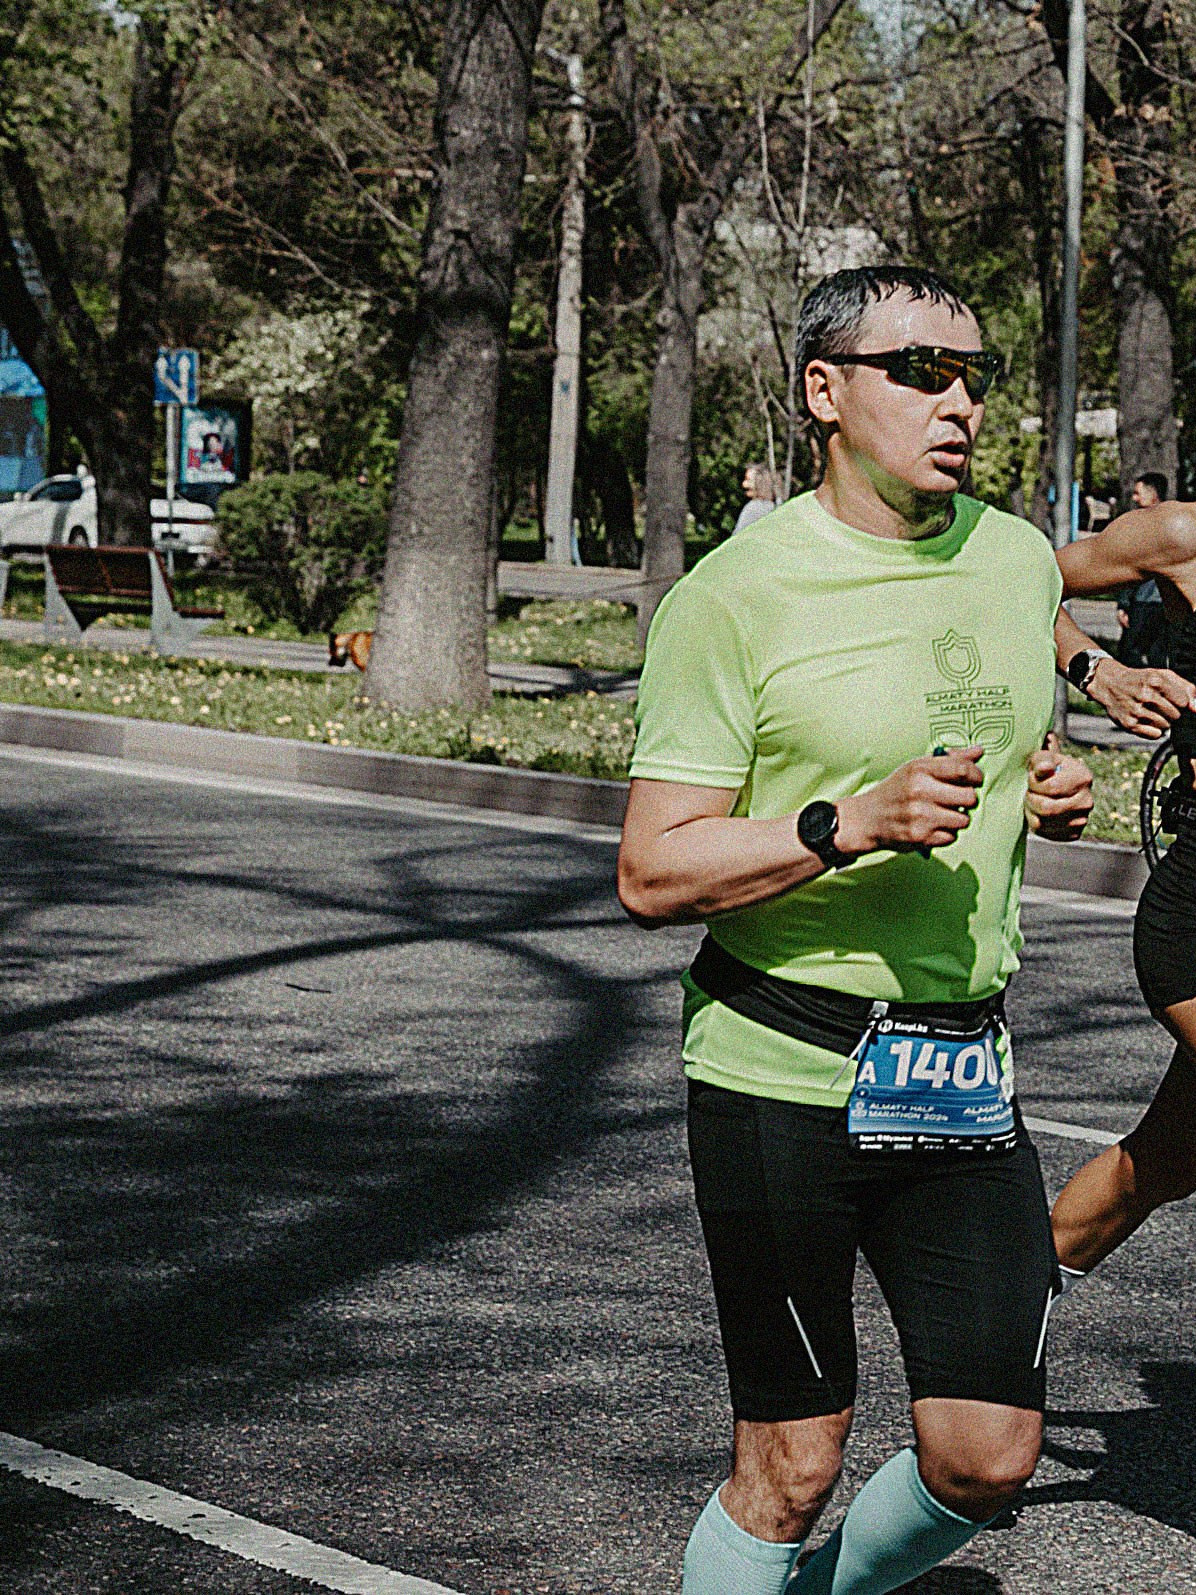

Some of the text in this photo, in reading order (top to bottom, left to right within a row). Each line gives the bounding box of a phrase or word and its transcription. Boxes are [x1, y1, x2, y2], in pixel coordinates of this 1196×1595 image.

[926, 688, 1010, 703] ALMATY HALF
[940, 700, 1012, 712] MARATHON
[857, 1061, 876, 1084] A
[869, 1103, 908, 1111] ALMATY
[868, 1110, 922, 1119] MARATHON
